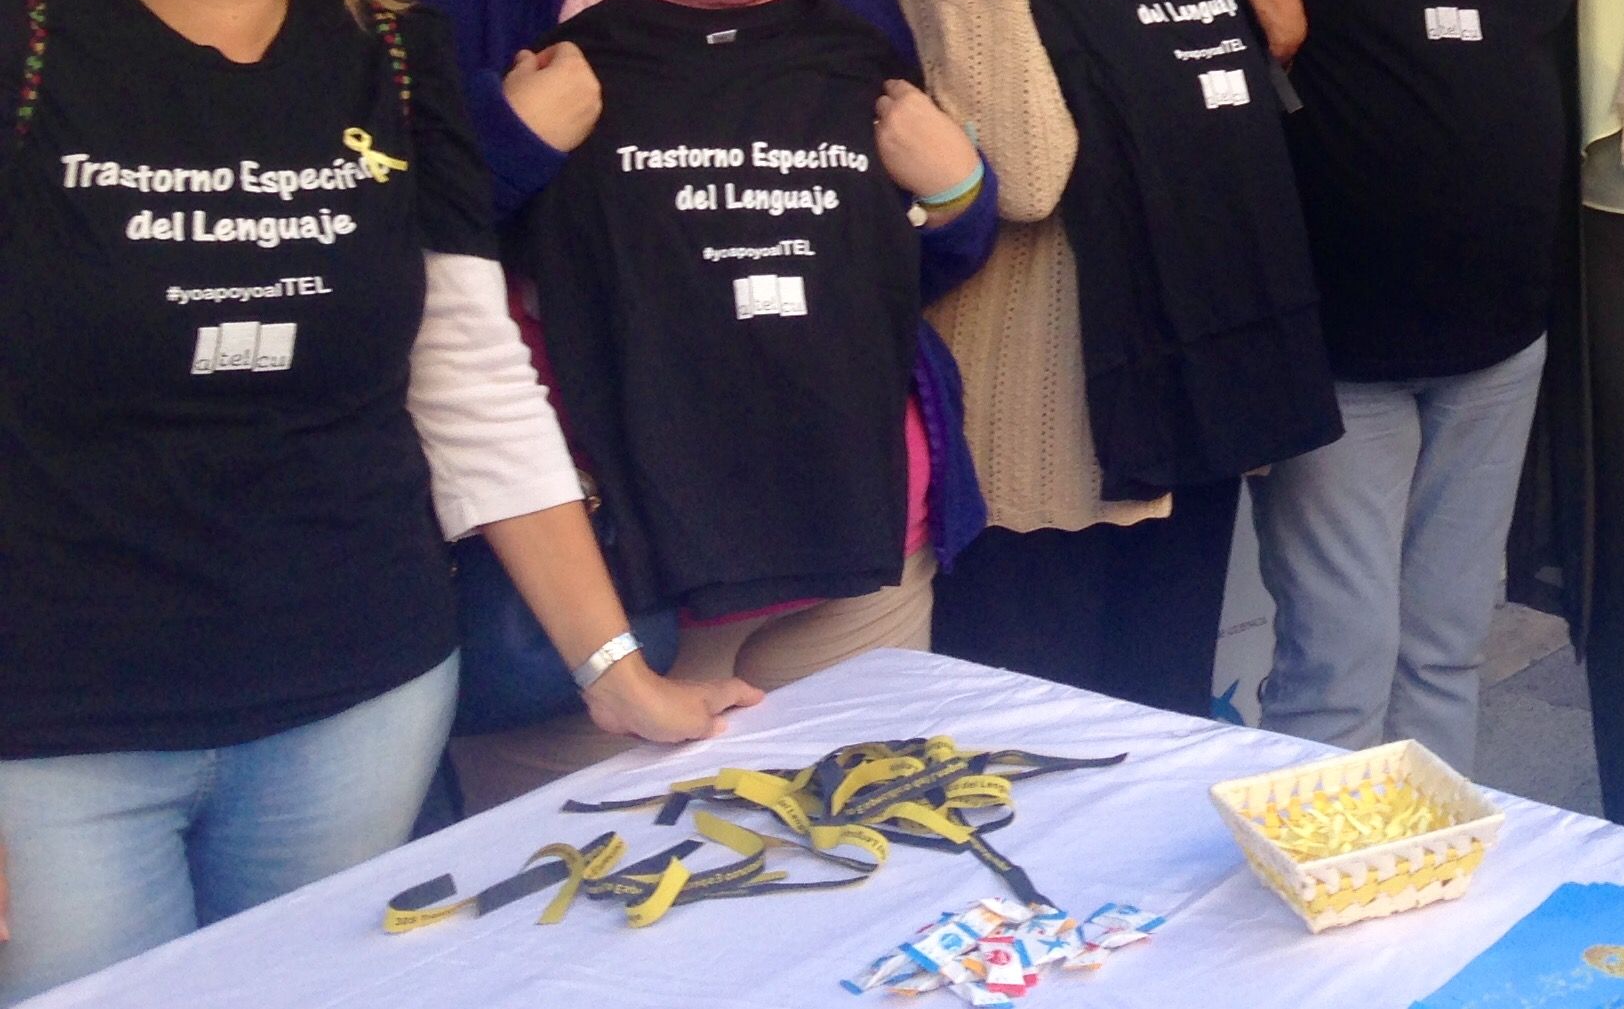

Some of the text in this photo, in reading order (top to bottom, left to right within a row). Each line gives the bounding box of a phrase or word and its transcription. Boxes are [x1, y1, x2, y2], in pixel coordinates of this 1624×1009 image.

[1137, 3, 1170, 25] del
[616, 141, 869, 175] Trastorno Específico
[61, 153, 391, 200] Trastorno Específi
[675, 182, 839, 216] del Lenguaje
[126, 207, 358, 248] del Lenguaje
[166, 275, 333, 305] #yoapoyoalTEL
